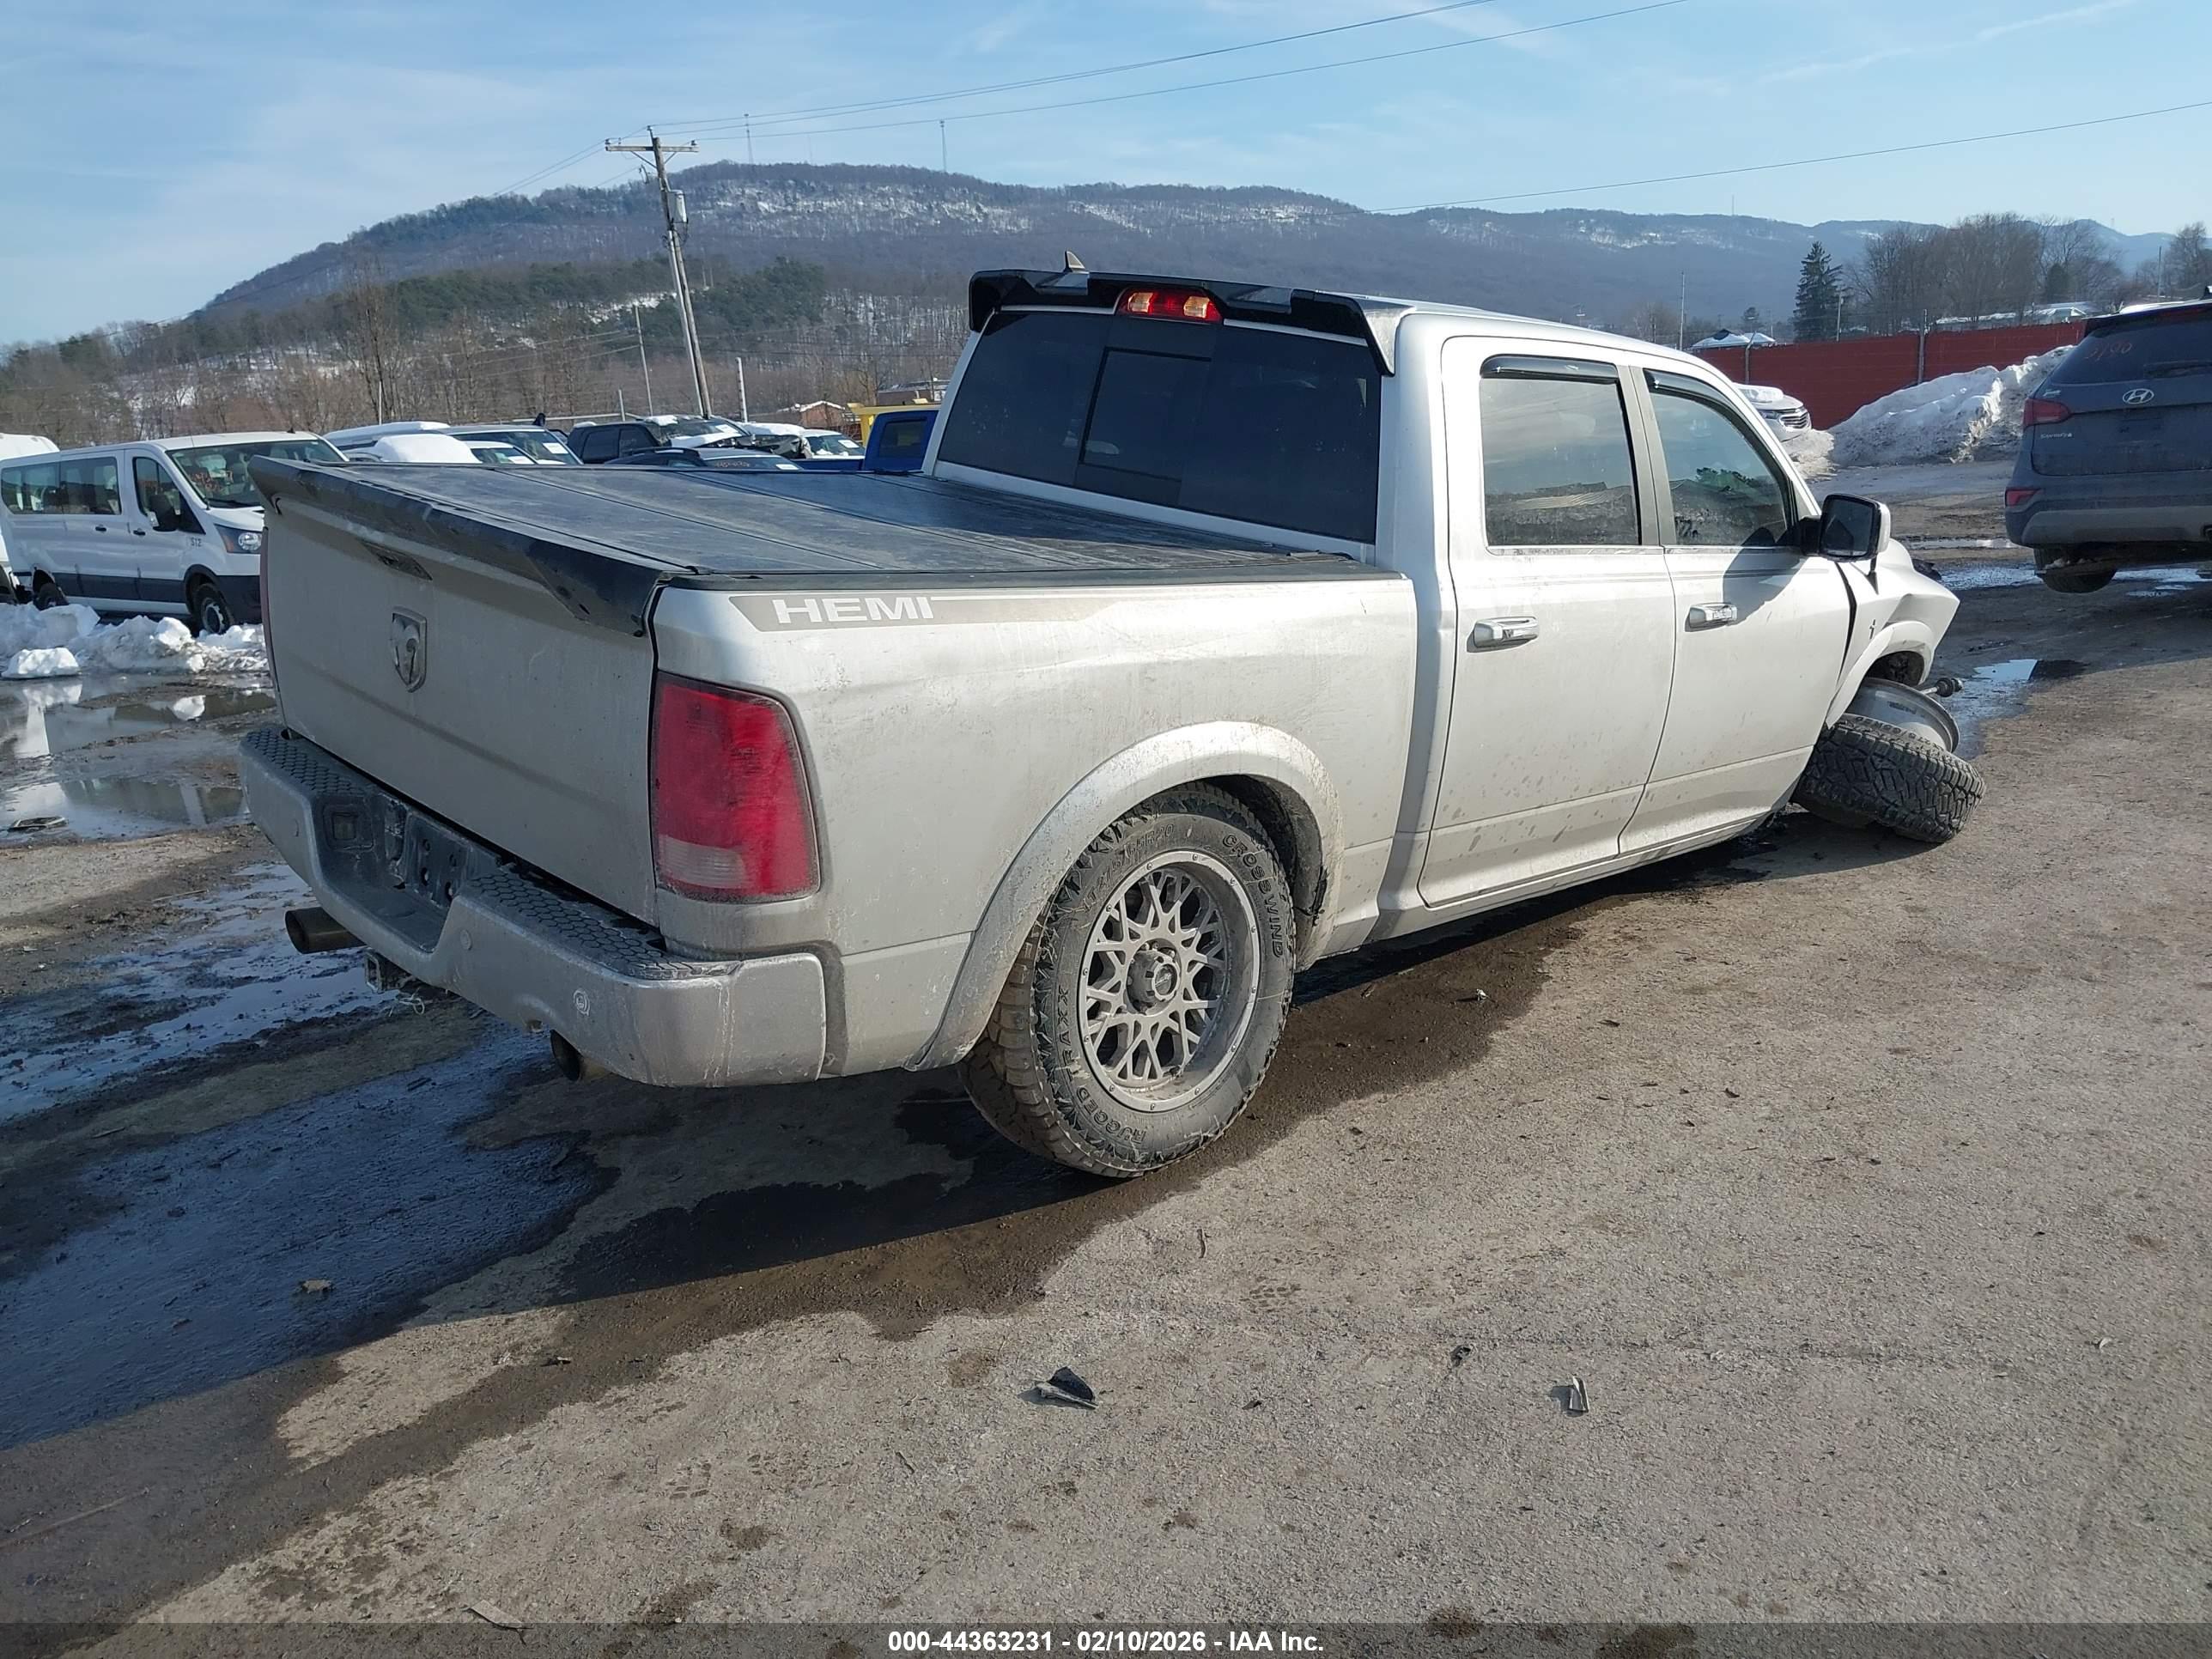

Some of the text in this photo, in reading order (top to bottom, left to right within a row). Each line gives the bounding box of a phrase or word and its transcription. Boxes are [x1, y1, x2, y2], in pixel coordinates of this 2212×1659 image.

[772, 597, 934, 624] HEMI
[1223, 834, 1284, 958] CROSSWIND
[1058, 984, 1149, 1145] RUGGED TRAXX
